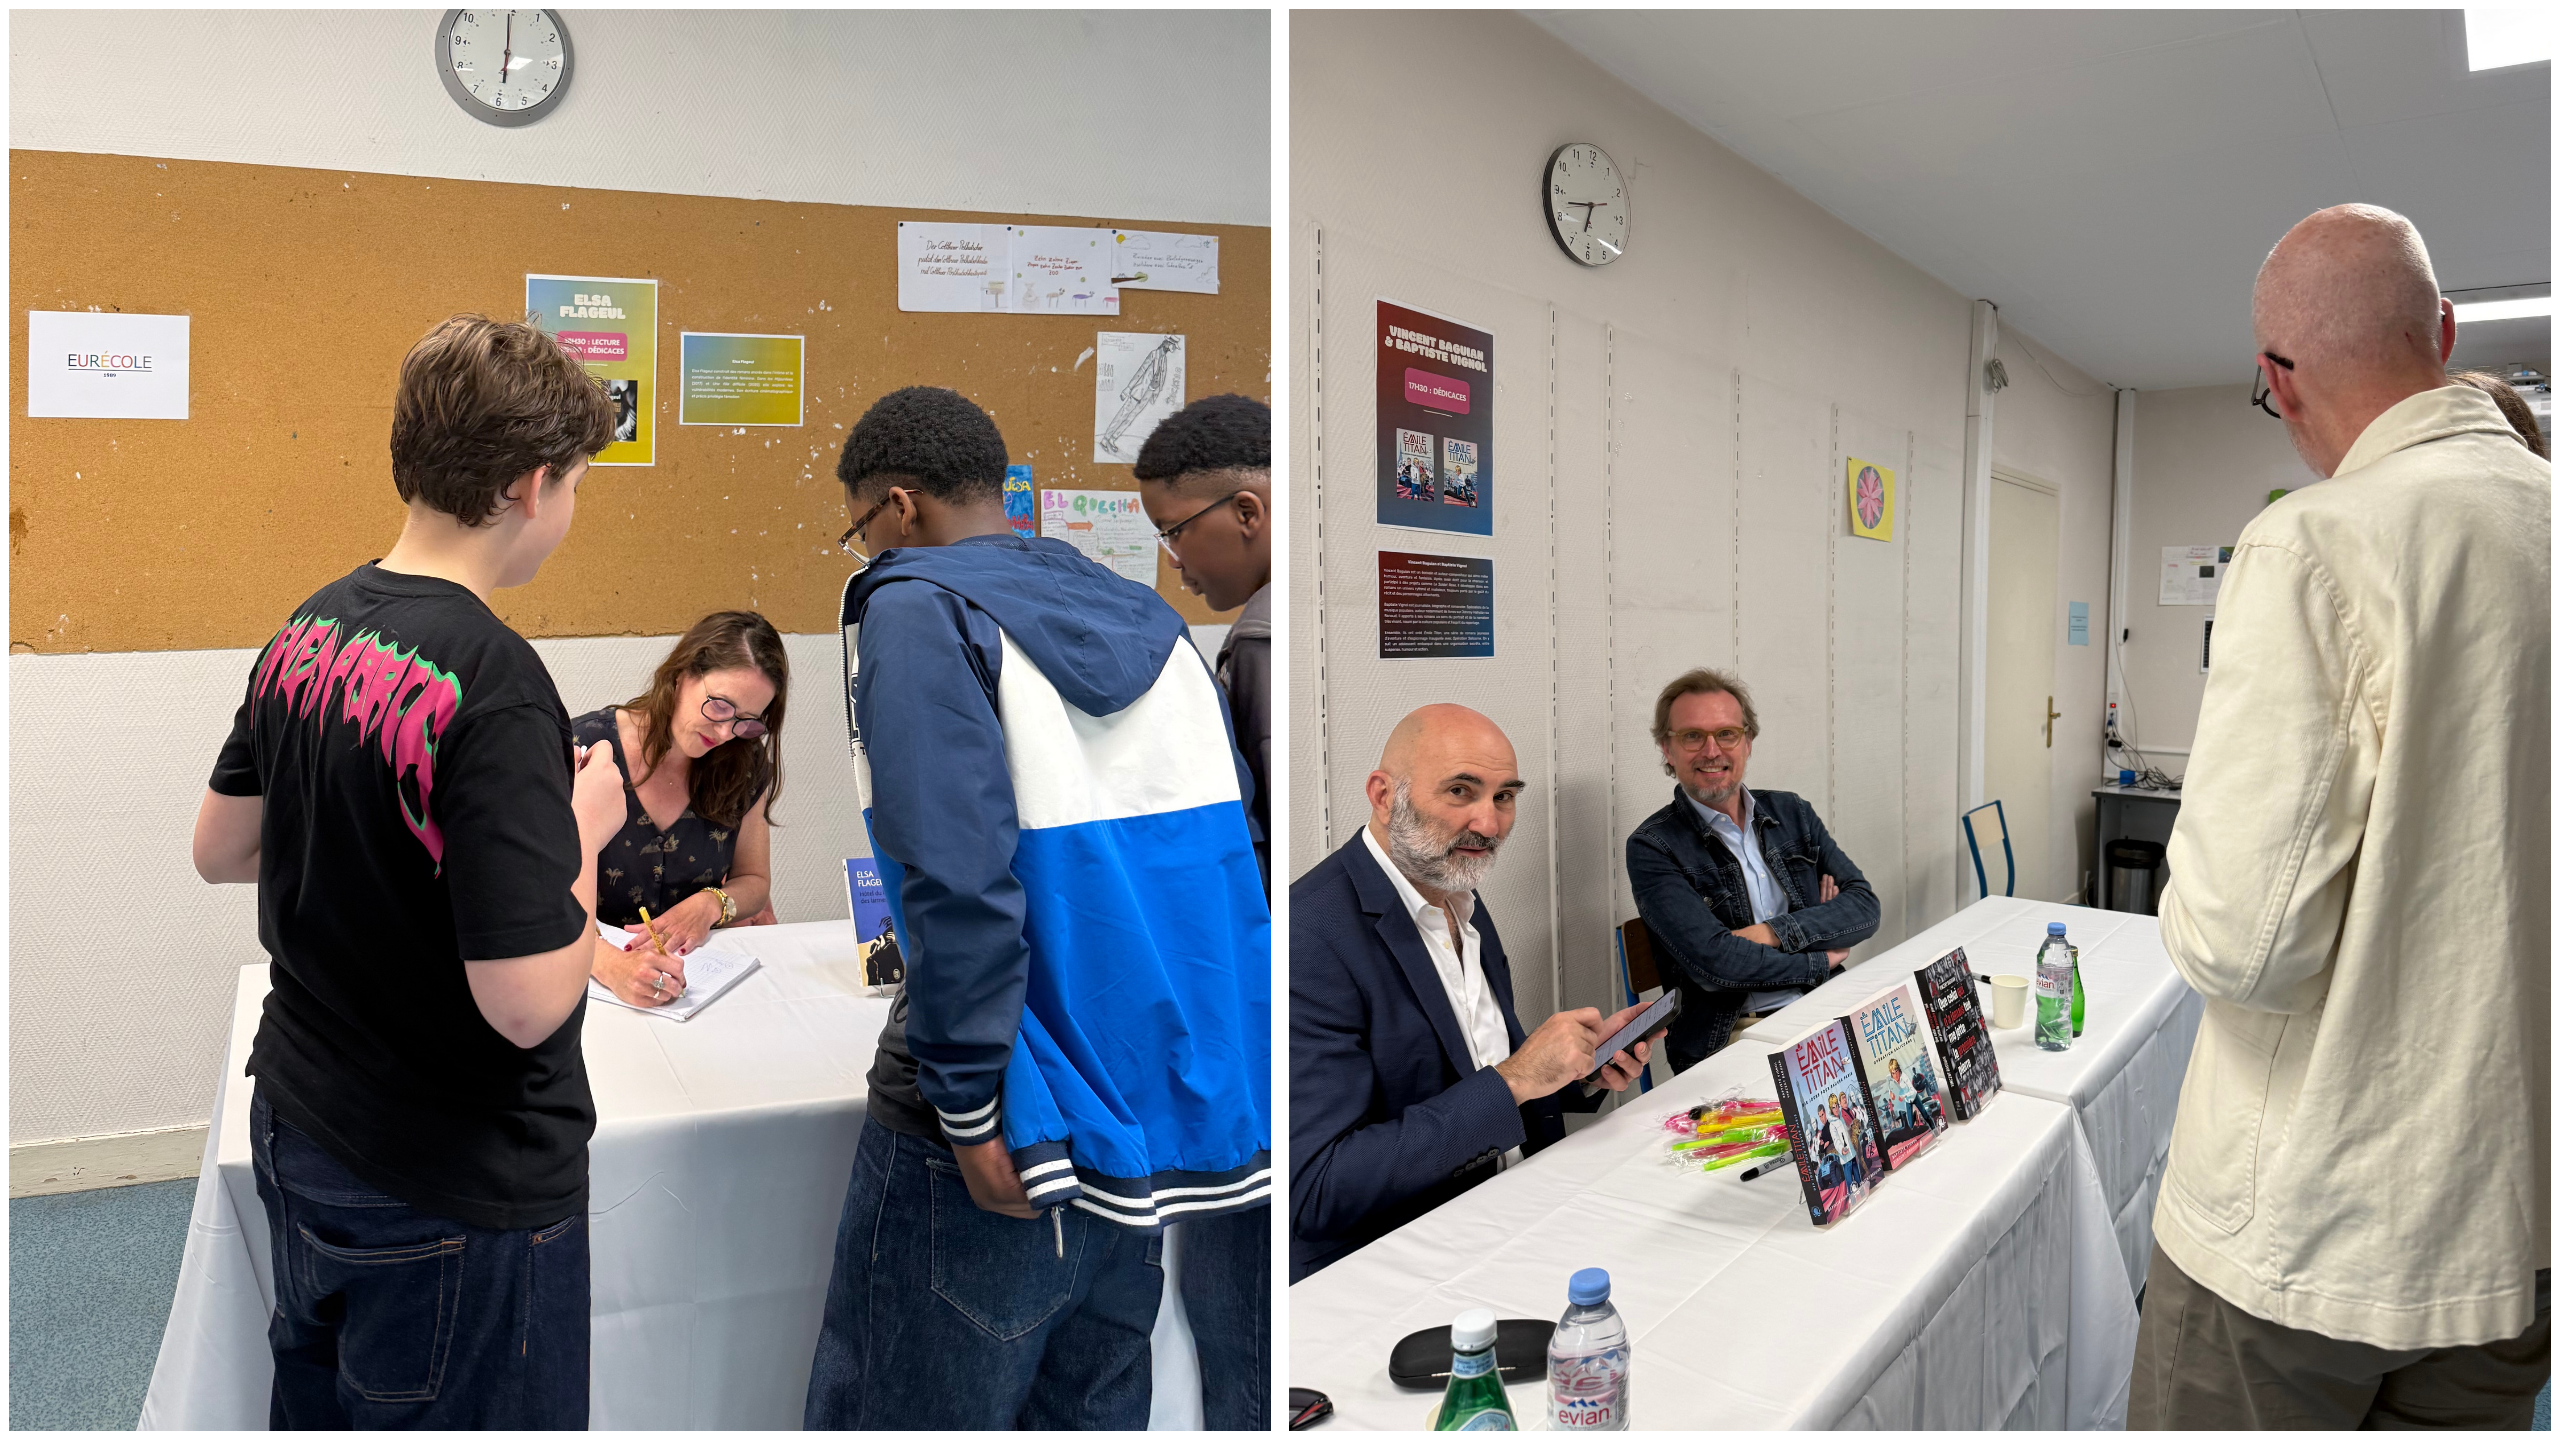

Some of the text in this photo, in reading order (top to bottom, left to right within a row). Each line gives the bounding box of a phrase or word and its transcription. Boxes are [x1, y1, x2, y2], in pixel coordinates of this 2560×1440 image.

[464, 12, 474, 22] 10
[536, 14, 540, 22] 1
[455, 36, 461, 45] 9
[549, 33, 556, 42] 2
[551, 61, 557, 70] 3
[473, 84, 479, 93] 7
[542, 84, 547, 92] 4
[496, 97, 501, 106] 6
[521, 96, 527, 105] 5
[574, 294, 612, 306] ELSA
[560, 306, 626, 319] FLAGEUL
[588, 346, 624, 354] DÉDICACES
[1389, 325, 1483, 361] VINCENT BAGUIAN
[68, 350, 152, 368] EURÉCOLE
[1385, 336, 1487, 373] & BAPTISTE VIGNOL
[1408, 382, 1428, 392] 17H30
[1433, 387, 1466, 401] DÉDICACES
[1404, 442, 1427, 455] TITAN
[1448, 450, 1472, 464] TITAN
[1043, 491, 1068, 510] EL
[1938, 997, 1948, 1012] Que
[1947, 988, 1958, 1004] celui
[1860, 997, 1903, 1037] ÉMILE
[1950, 1005, 1965, 1023] jamais
[1866, 1018, 1910, 1058] TITAN
[1955, 1024, 1966, 1040] jette
[1795, 1028, 1839, 1072] ÉMILE
[1957, 1035, 1976, 1058] première
[1802, 1052, 1845, 1094] TITAN
[1958, 1058, 1971, 1079] pierre
[1789, 1124, 1803, 1152] TITAN
[1558, 1407, 1609, 1425] evian
